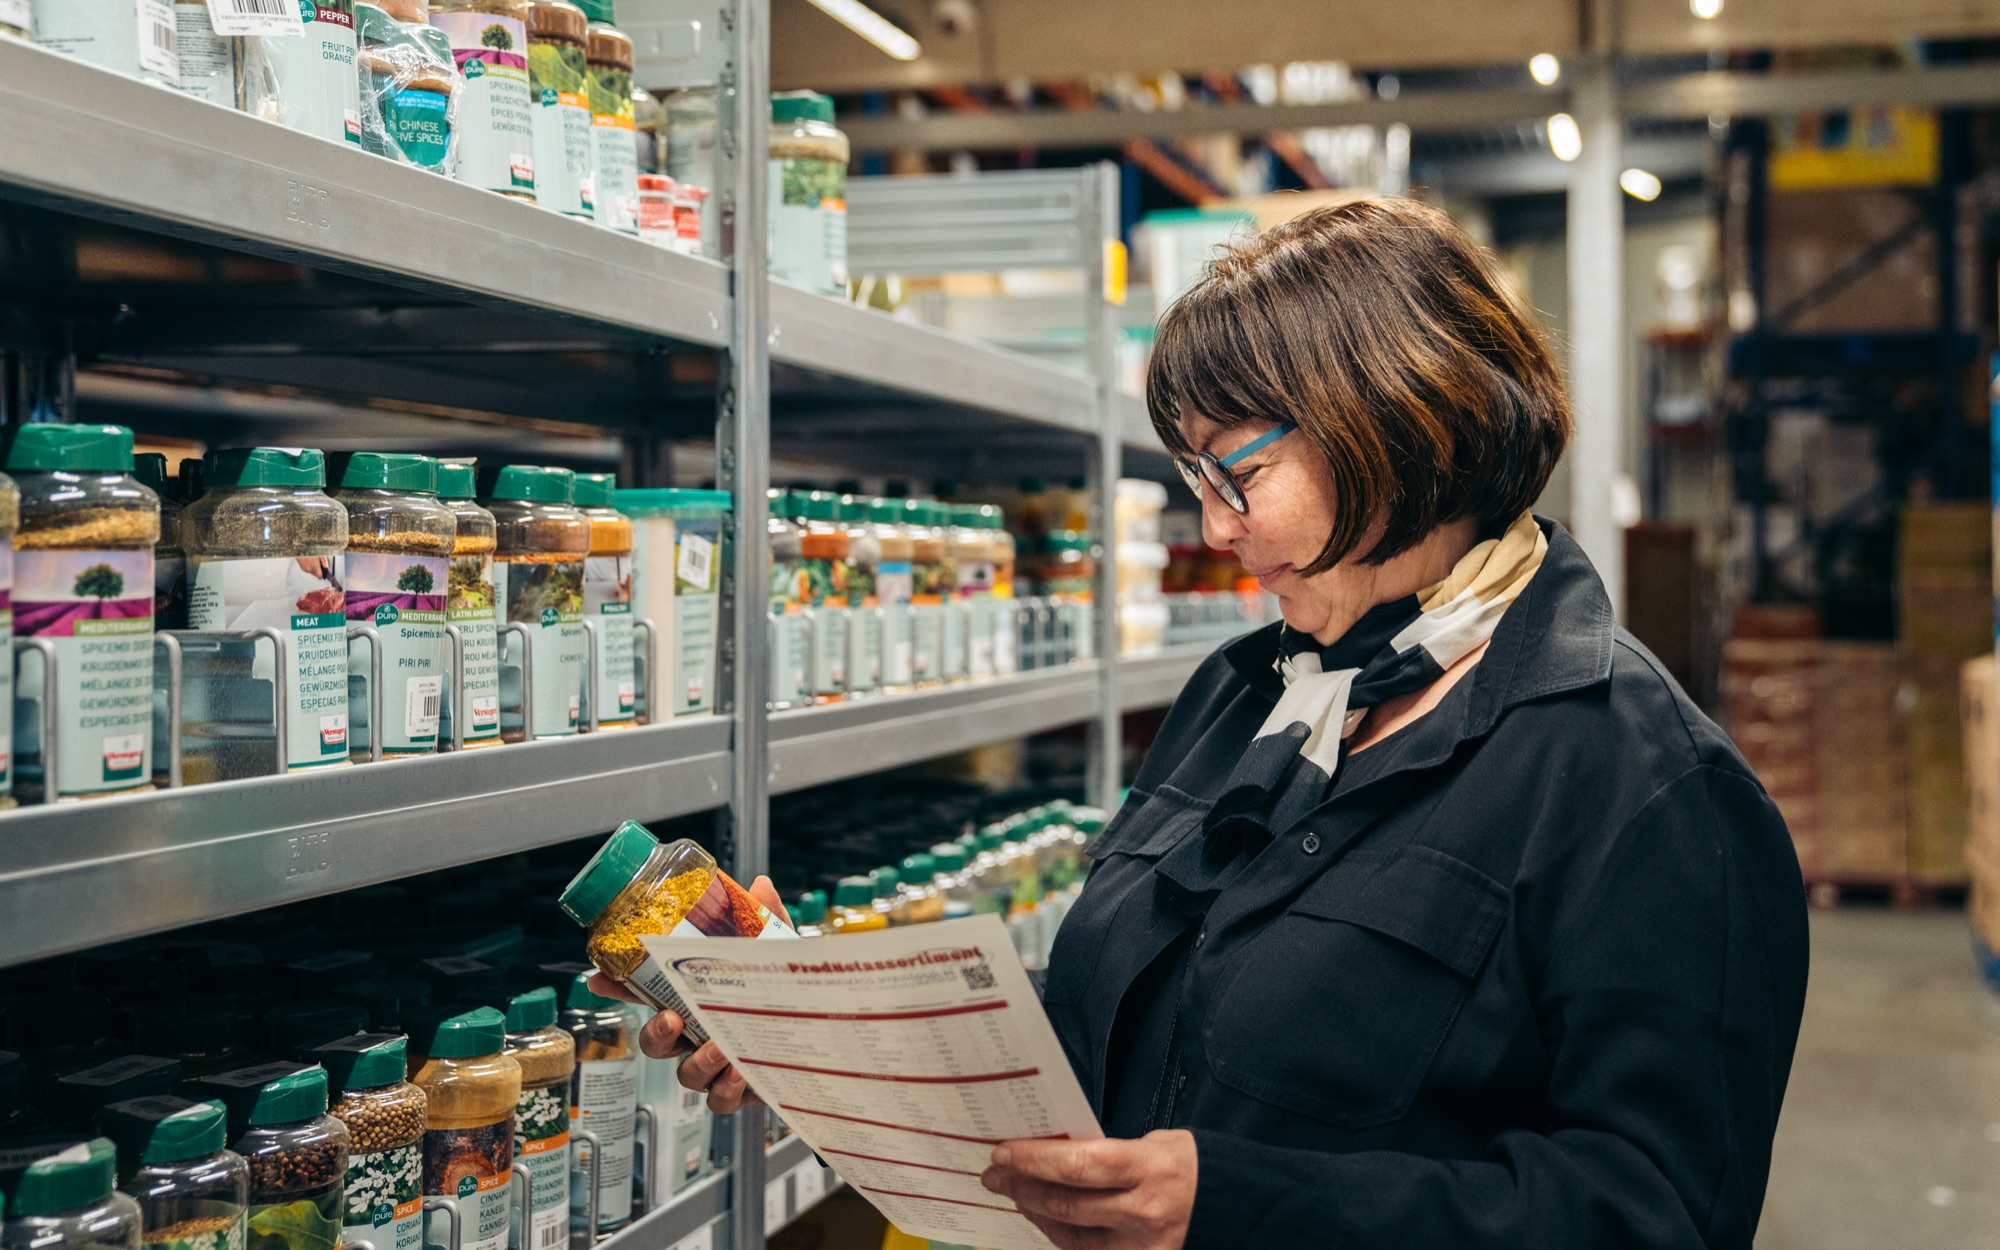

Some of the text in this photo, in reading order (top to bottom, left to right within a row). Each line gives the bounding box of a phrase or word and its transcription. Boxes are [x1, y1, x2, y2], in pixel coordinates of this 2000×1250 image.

[320, 10, 350, 24] PEPPER
[322, 42, 345, 52] FRUIT
[322, 51, 353, 65] ORANGE
[465, 65, 486, 75] pure
[399, 120, 439, 133] CHINESE
[416, 132, 444, 146] SPICES
[376, 611, 398, 621] pure
[451, 610, 472, 619] LATIN
[541, 614, 559, 624] pure
[296, 617, 319, 628] MEAT
[458, 623, 475, 634] ERU
[297, 632, 335, 646] SPICEMIX
[400, 627, 436, 639] Spicemix
[463, 638, 476, 648] RU
[298, 648, 342, 661] KRUIDENMIX
[464, 651, 481, 662] ROU
[398, 658, 432, 668] PIRI PIRI
[299, 664, 337, 677] MÉLANGE
[462, 680, 490, 691] SPECIAS
[300, 697, 338, 710] ESPECIAS
[525, 1141, 545, 1152] SPICE
[531, 1163, 565, 1181] ORIANDER
[458, 1177, 499, 1193] pure SPICE
[374, 1203, 414, 1222] pure SPICE
[479, 1204, 505, 1219] KANEEL
